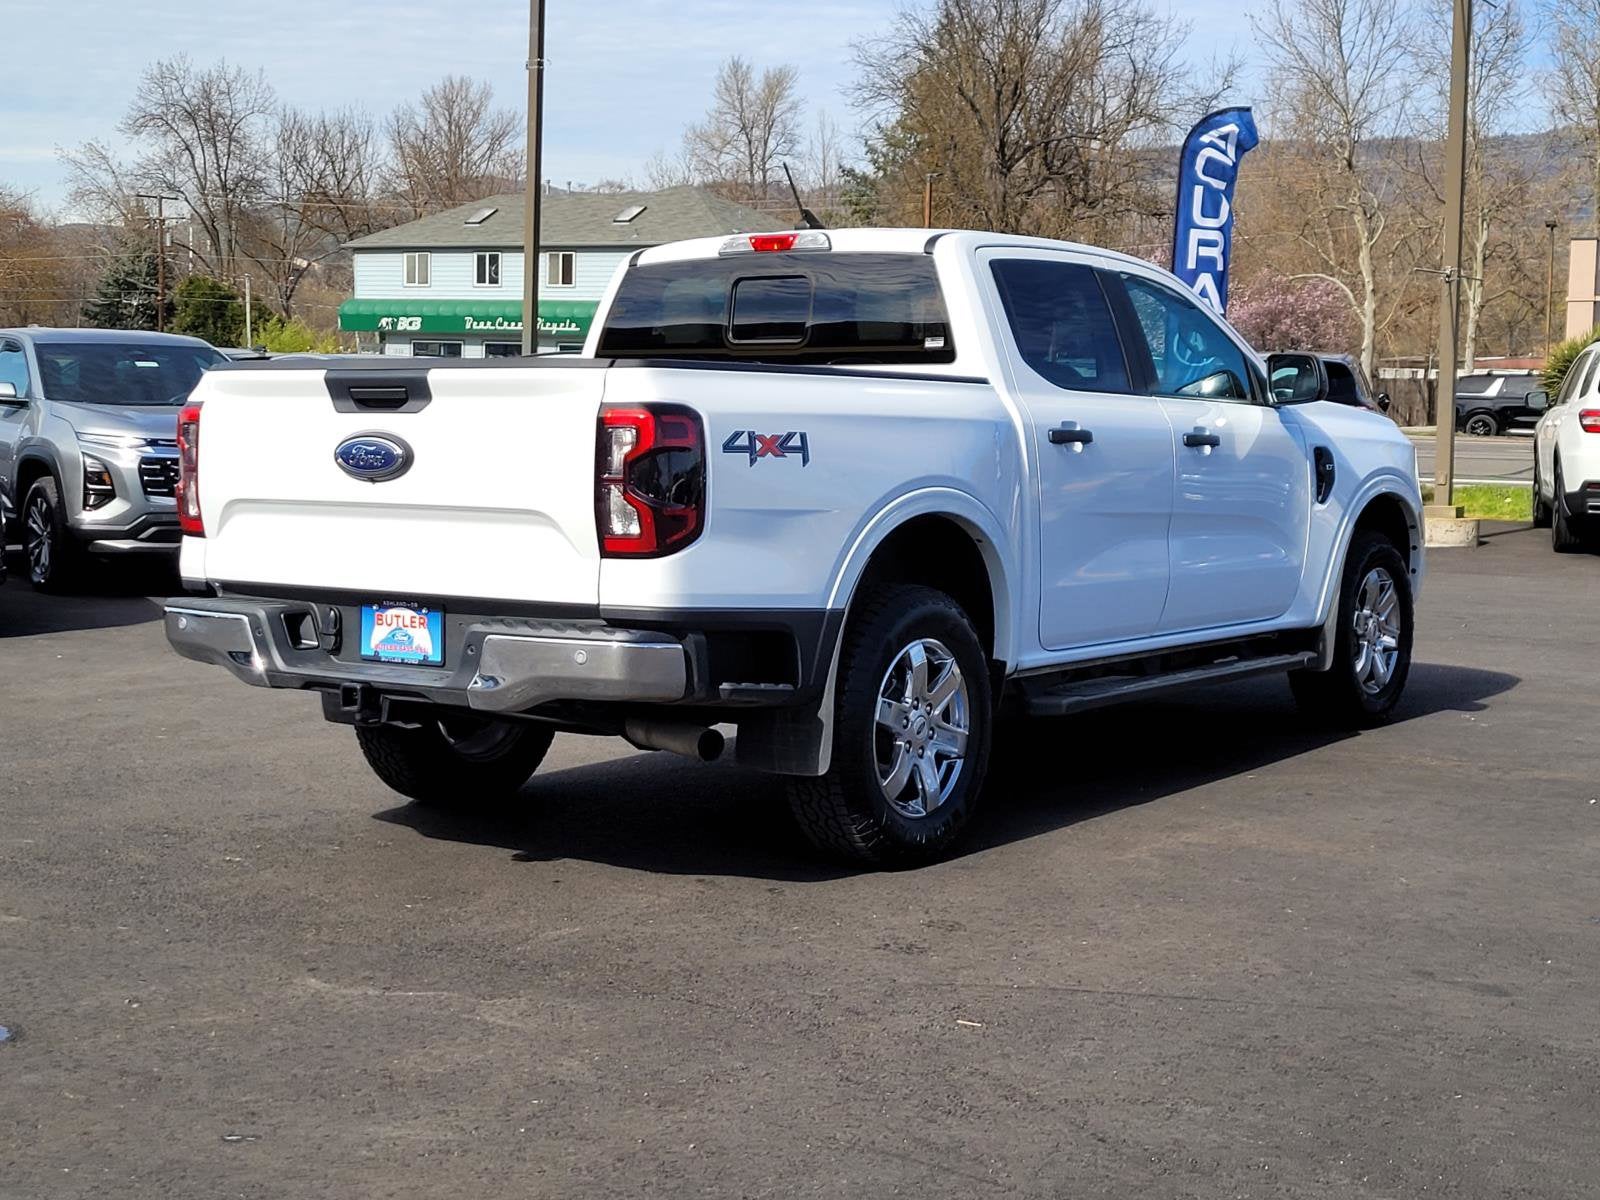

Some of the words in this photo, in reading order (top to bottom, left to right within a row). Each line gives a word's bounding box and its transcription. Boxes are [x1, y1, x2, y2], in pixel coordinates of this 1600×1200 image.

[1186, 122, 1240, 314] ACURA
[464, 316, 495, 330] Bear
[495, 316, 524, 330] Cree
[348, 444, 386, 466] Ford
[375, 612, 427, 630] BUTLER
